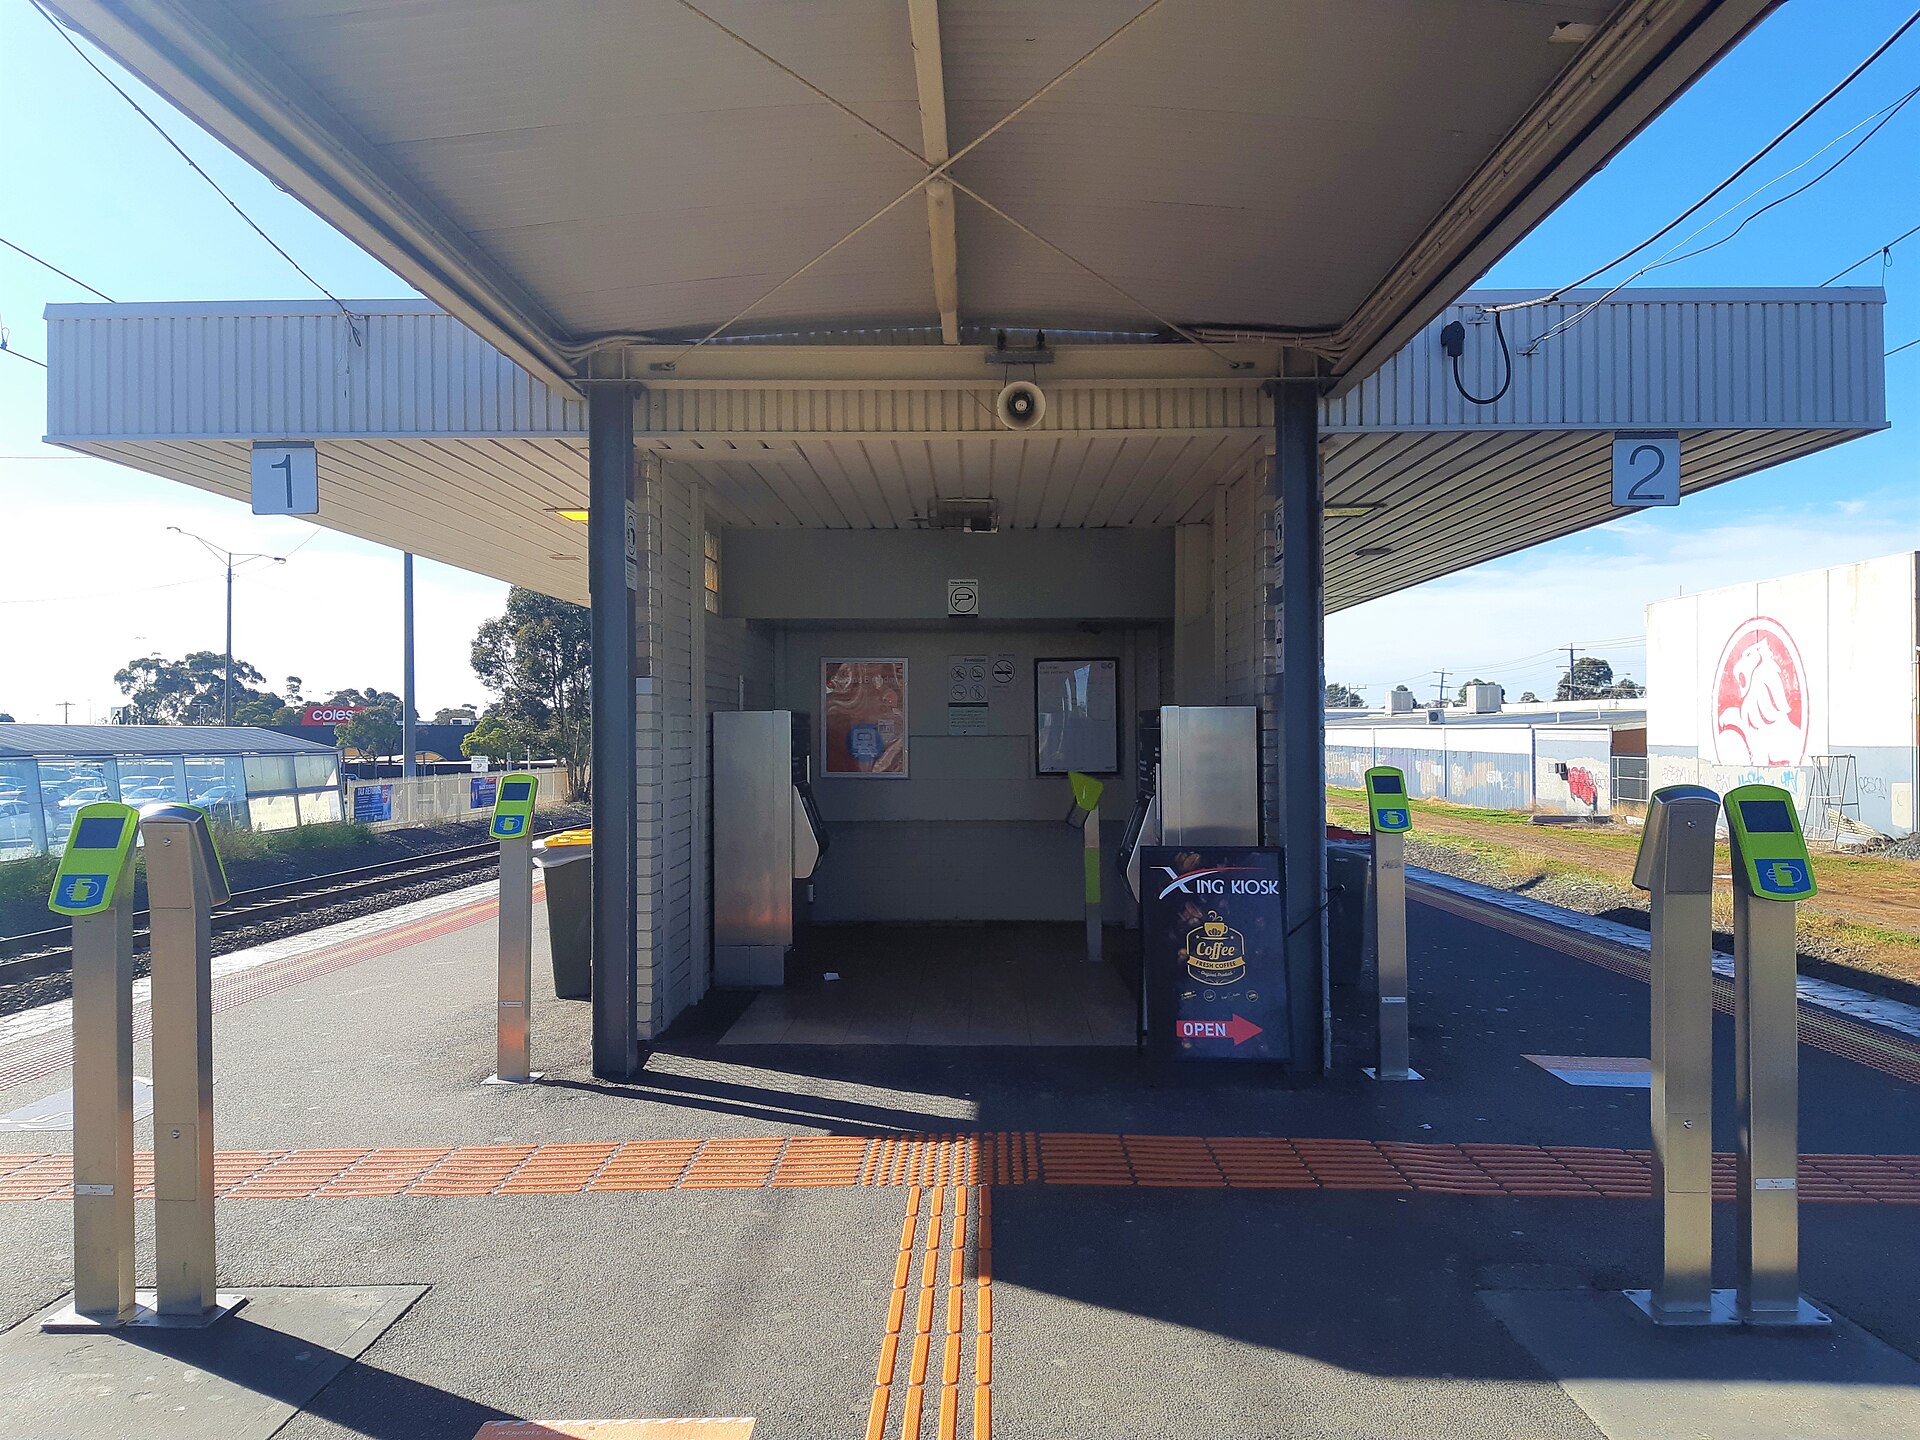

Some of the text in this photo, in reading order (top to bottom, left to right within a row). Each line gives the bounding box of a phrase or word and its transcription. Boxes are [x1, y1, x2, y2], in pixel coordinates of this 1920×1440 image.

[1628, 445, 1665, 499] 2
[271, 454, 293, 508] 1
[312, 709, 353, 721] coles
[1231, 879, 1279, 895] KIOSK
[1196, 941, 1236, 960] Coffee
[1195, 960, 1236, 969] FRESH COFFEE
[1183, 1022, 1226, 1037] OPEN
